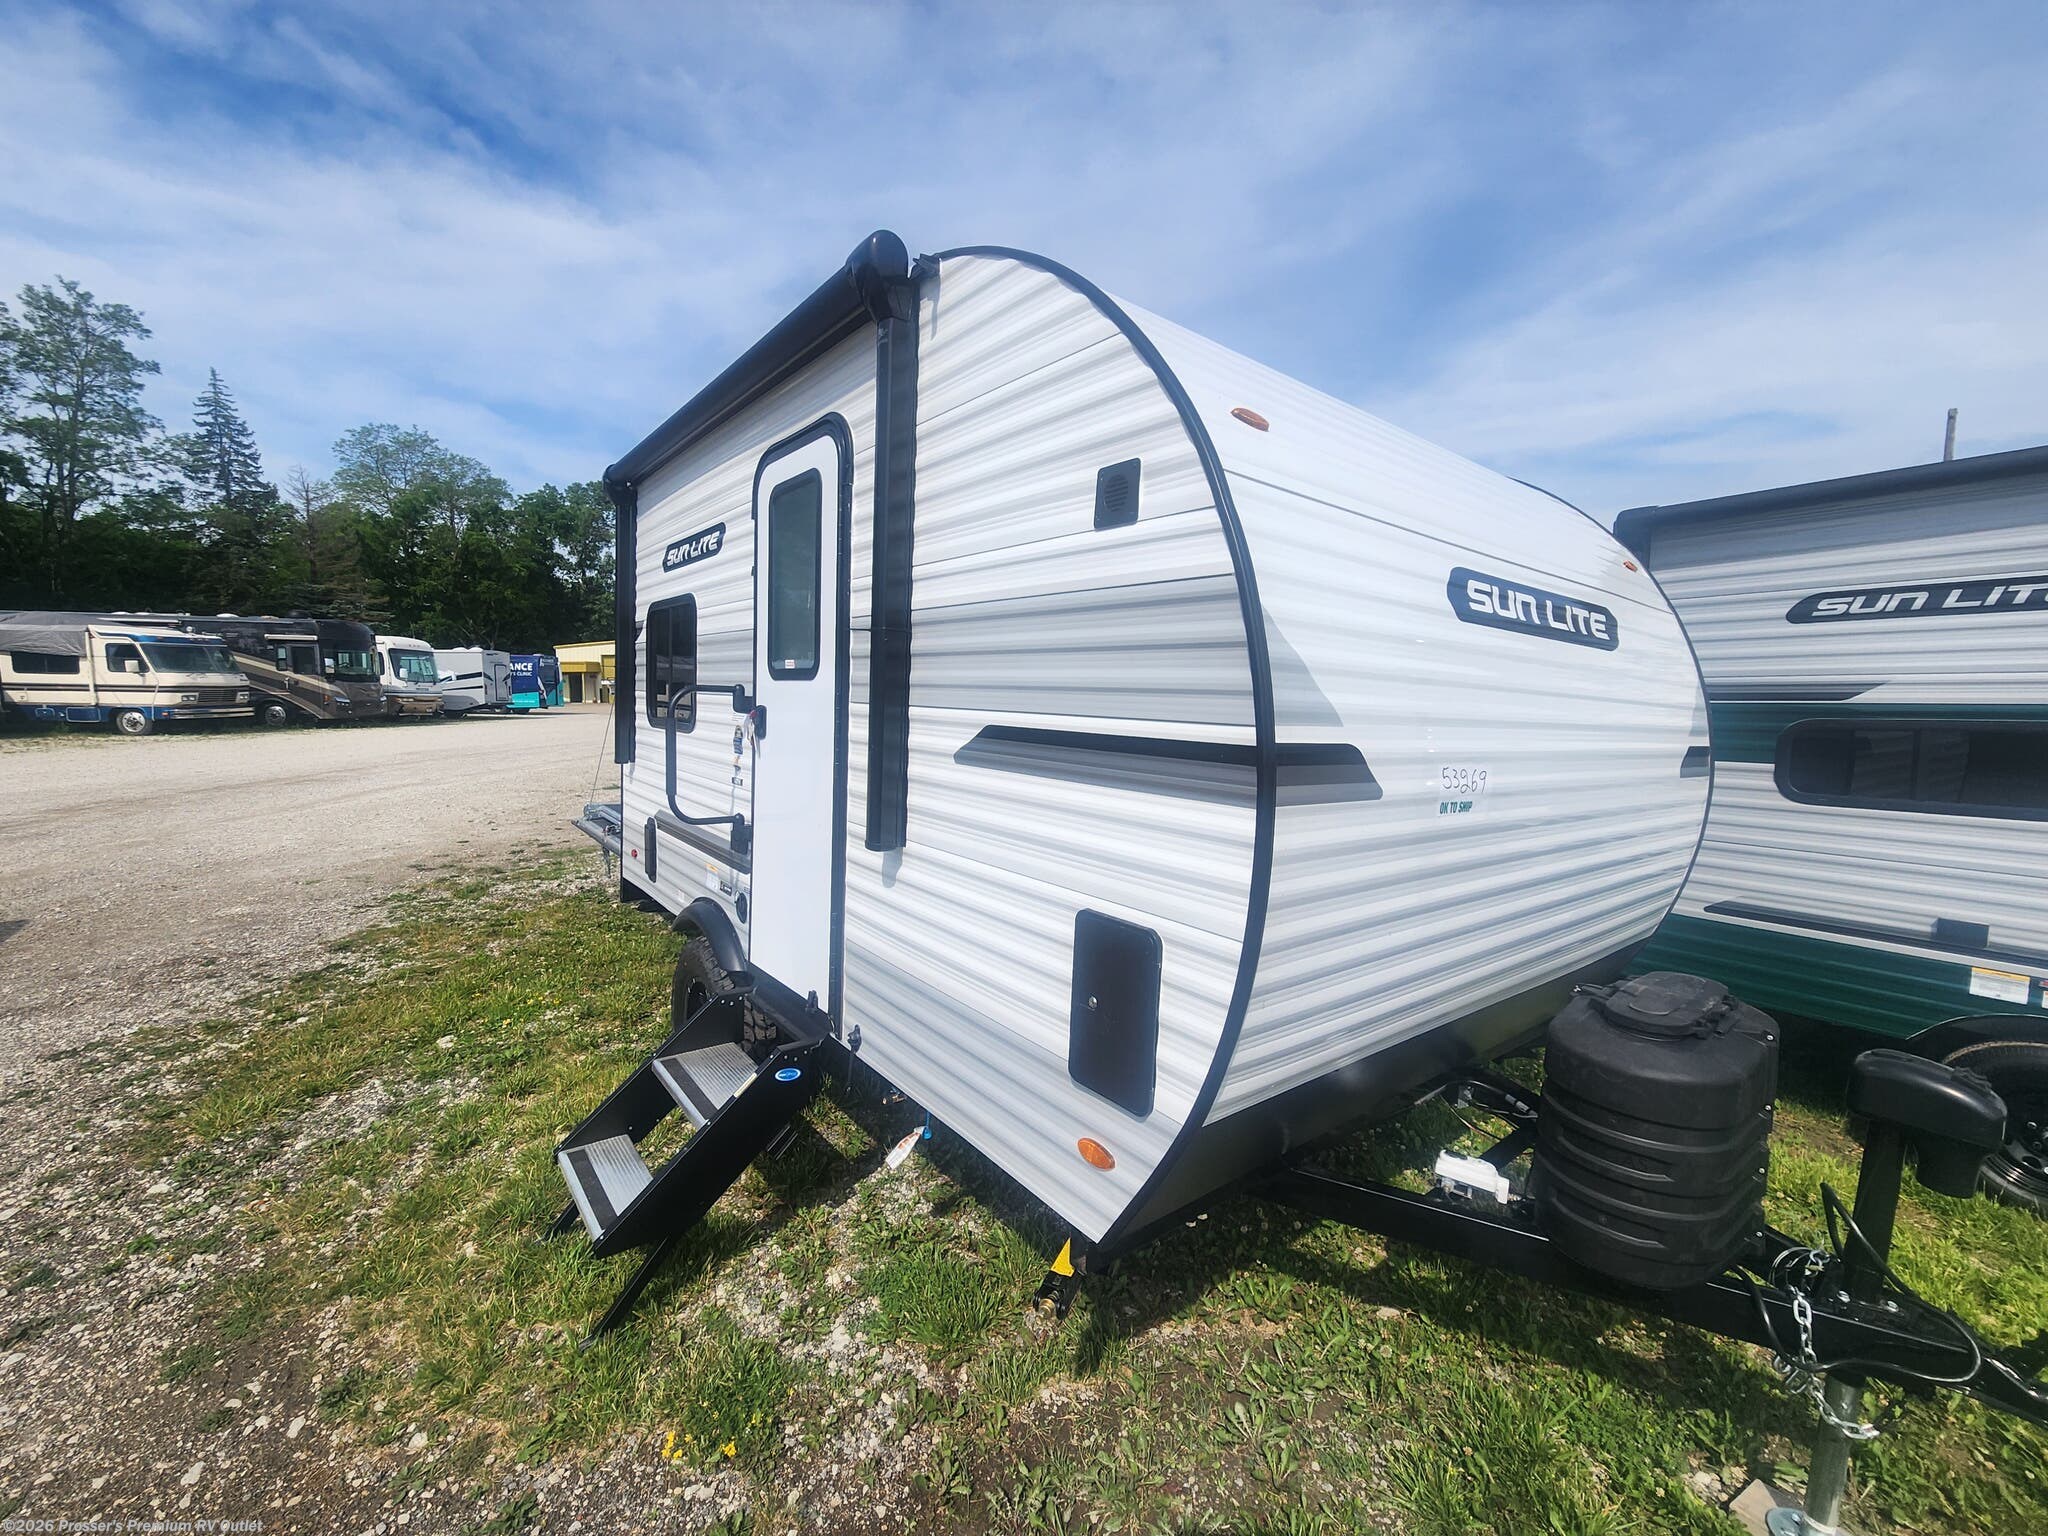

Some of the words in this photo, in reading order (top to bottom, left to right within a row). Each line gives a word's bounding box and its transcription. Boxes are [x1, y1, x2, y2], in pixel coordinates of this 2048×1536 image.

[666, 543, 690, 567] SUN
[690, 531, 720, 558] LITE
[1467, 579, 1541, 625] SUN
[1546, 599, 1610, 640] LITE
[1811, 591, 1930, 616] SUN
[1442, 766, 1487, 794] 53269
[1440, 801, 1449, 815] OK
[1450, 801, 1458, 814] TO
[1458, 801, 1473, 813] SHIP
